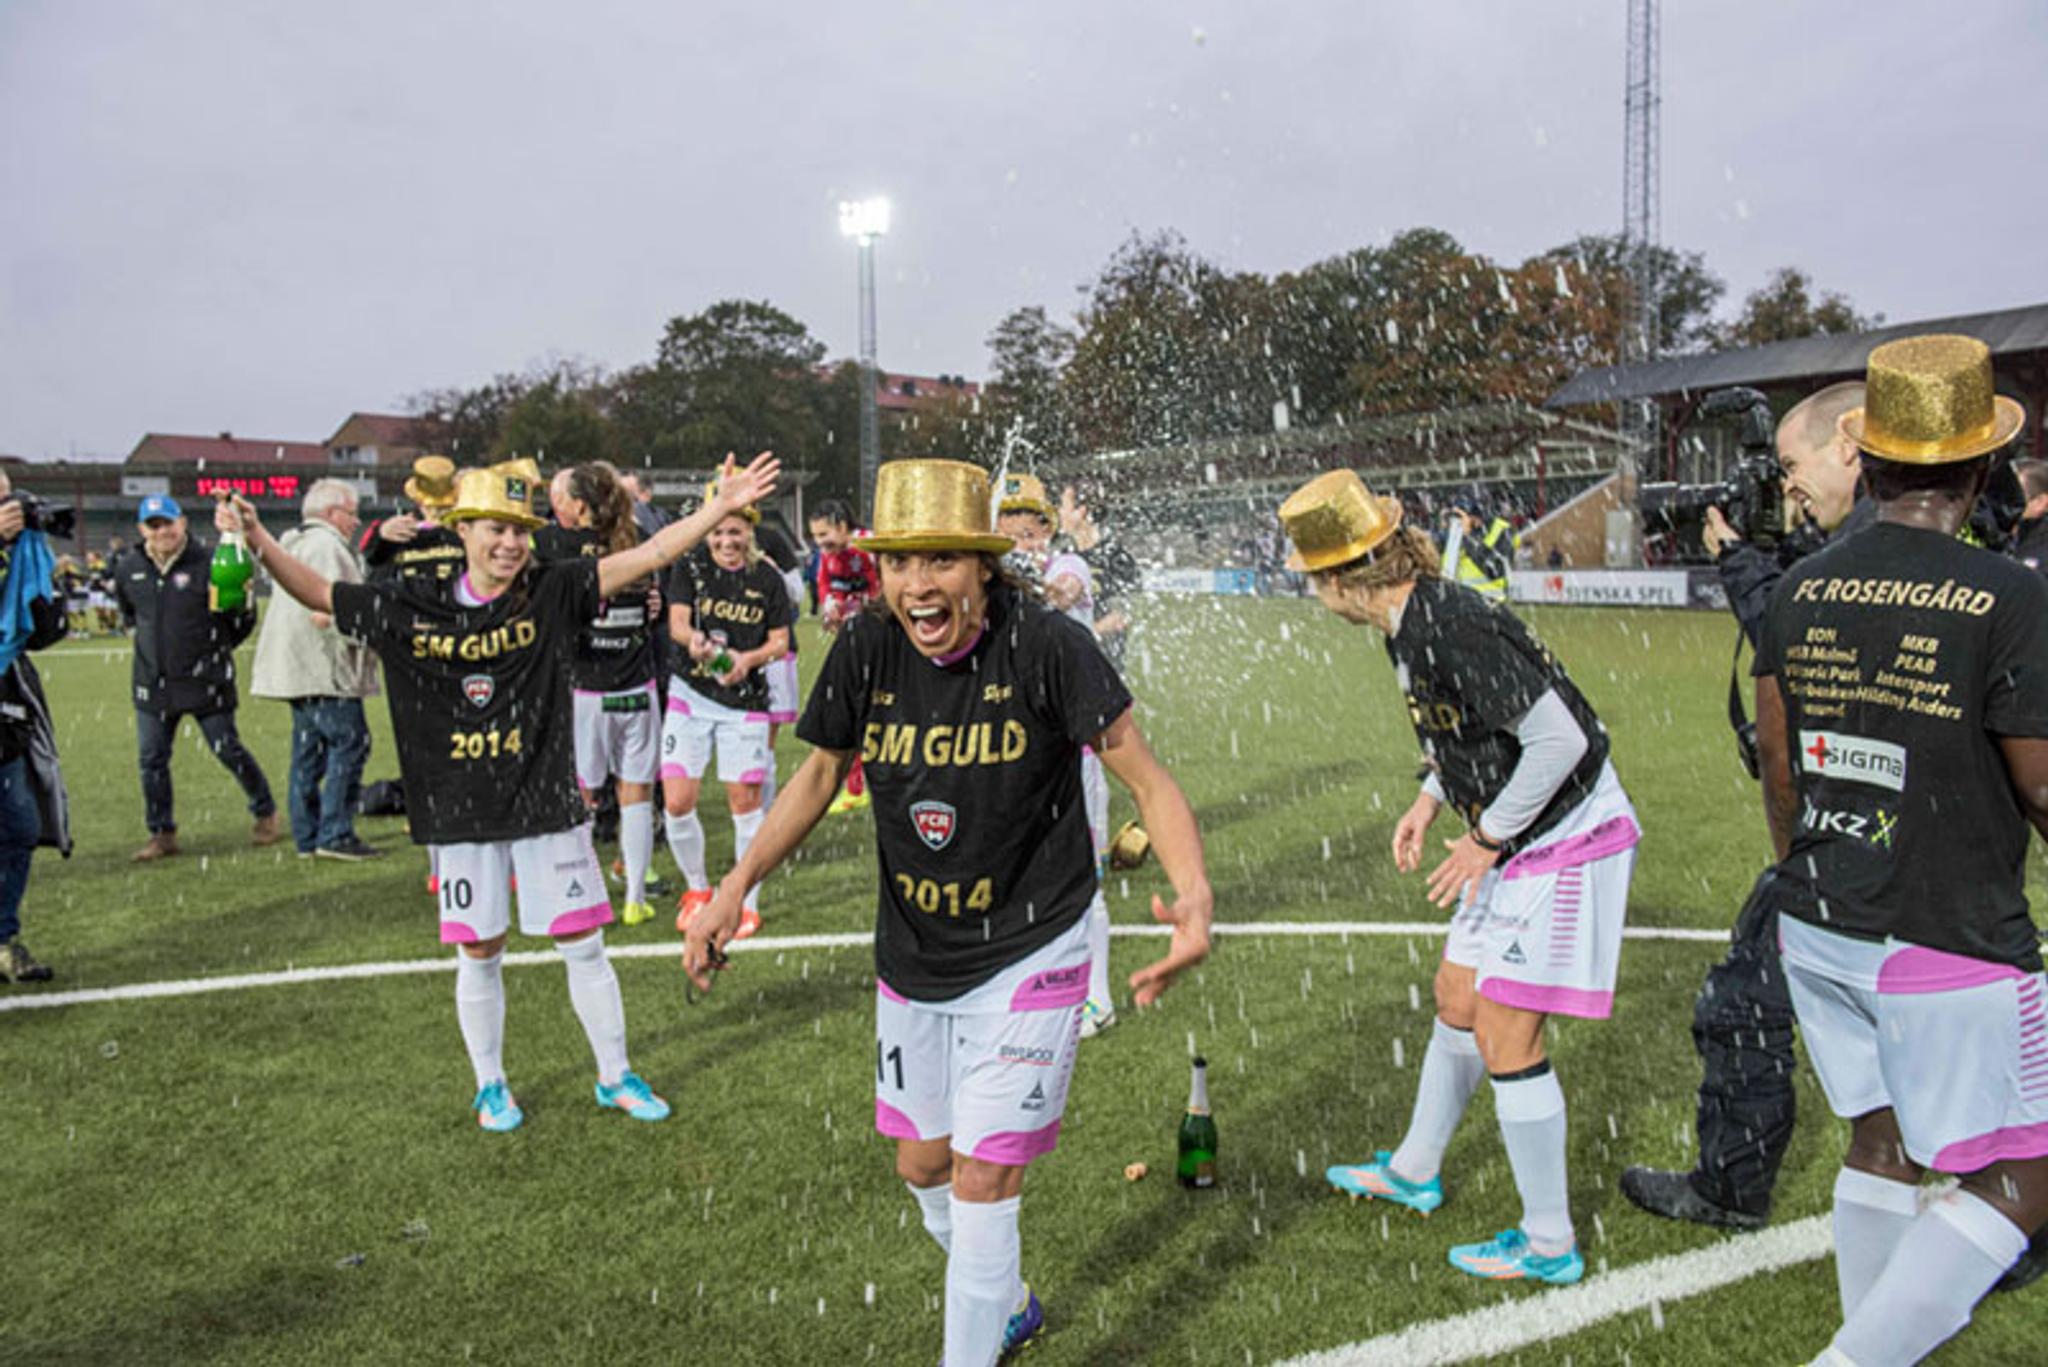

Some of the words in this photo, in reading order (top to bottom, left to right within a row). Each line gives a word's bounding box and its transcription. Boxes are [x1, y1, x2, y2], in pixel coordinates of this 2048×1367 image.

[1793, 578, 1825, 602] FC
[1822, 578, 1996, 616] ROSENGÅRD
[412, 634, 456, 660] SM
[459, 620, 537, 662] GULD
[1901, 634, 1940, 654] MKB
[1894, 653, 1938, 675] PEAB
[1907, 696, 1963, 720] Anders
[451, 727, 523, 760] 2014
[664, 732, 677, 755] 9
[861, 722, 918, 765] SM
[922, 718, 1027, 767] GULD
[442, 878, 473, 910] 10
